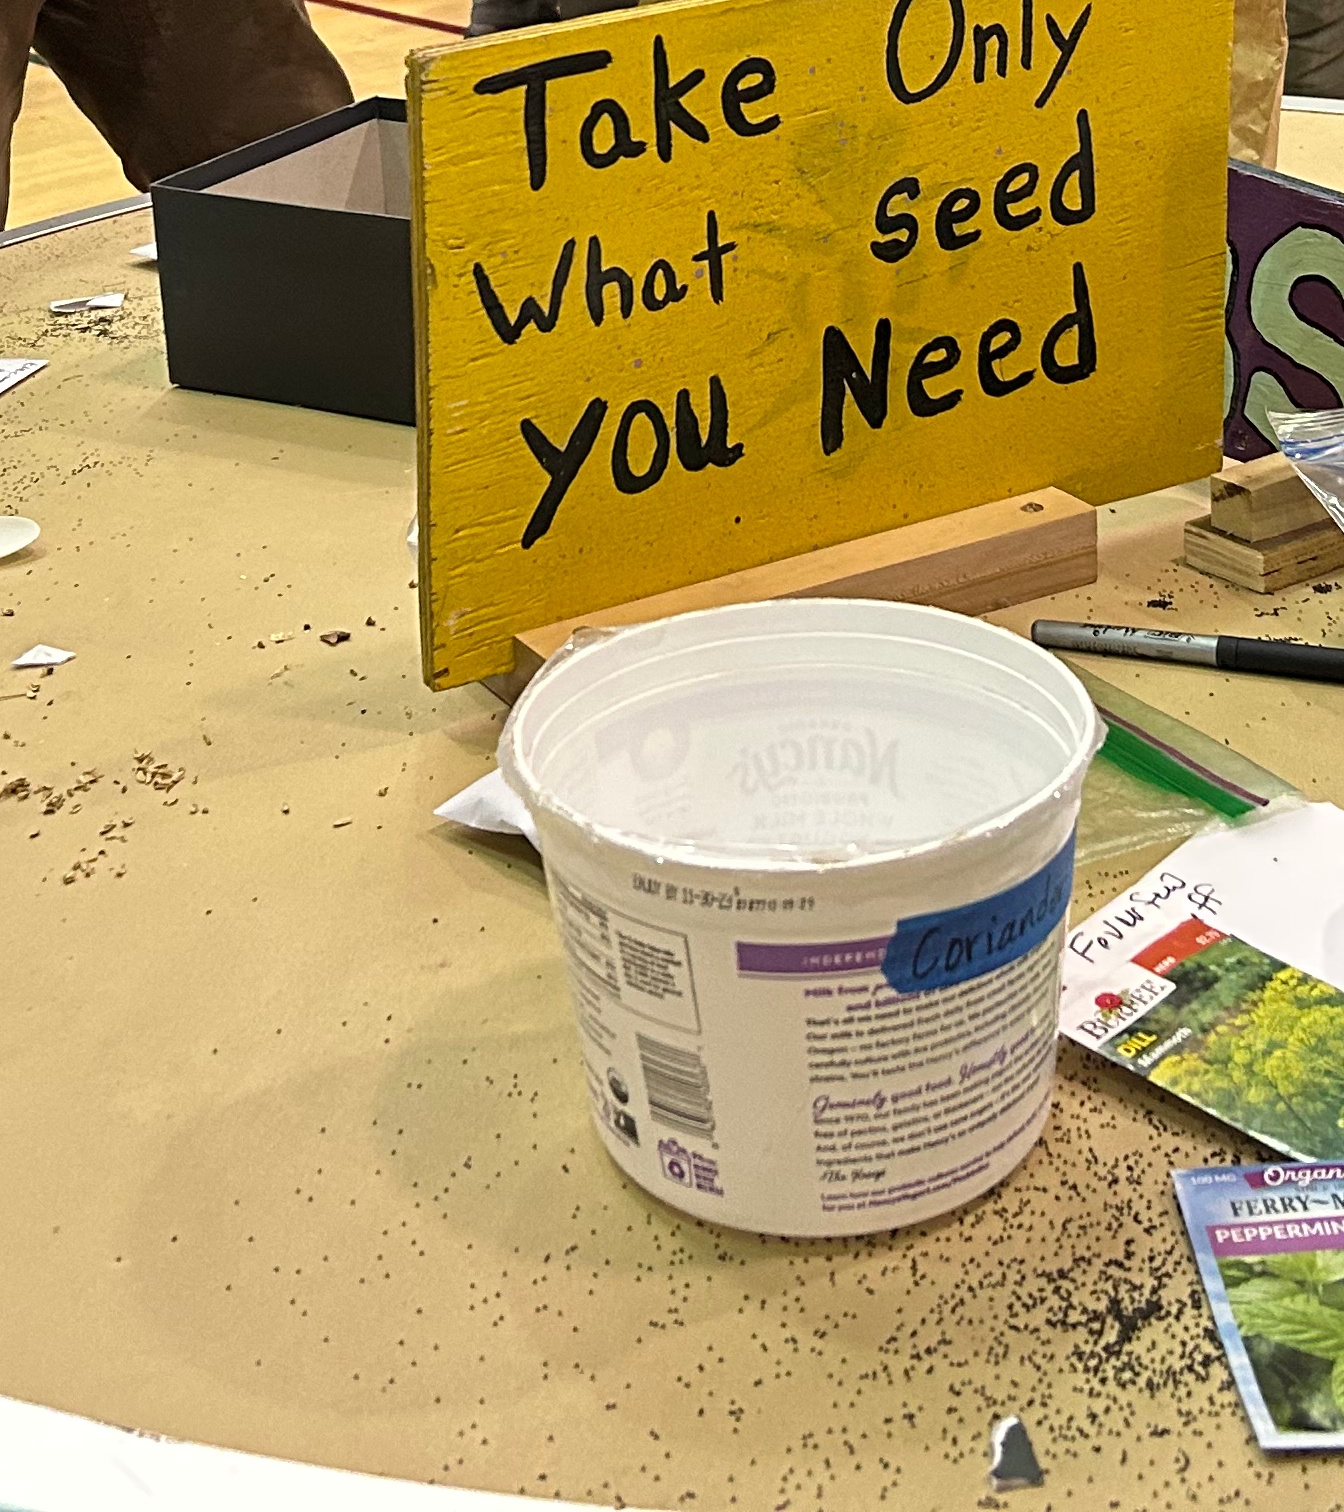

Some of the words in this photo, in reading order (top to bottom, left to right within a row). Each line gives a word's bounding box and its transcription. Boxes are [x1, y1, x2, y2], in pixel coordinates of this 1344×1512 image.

[473, 33, 783, 193] Take
[473, 209, 736, 348] What
[869, 108, 1099, 263] seed
[822, 263, 1099, 458] Need
[1117, 1031, 1158, 1058] DILL
